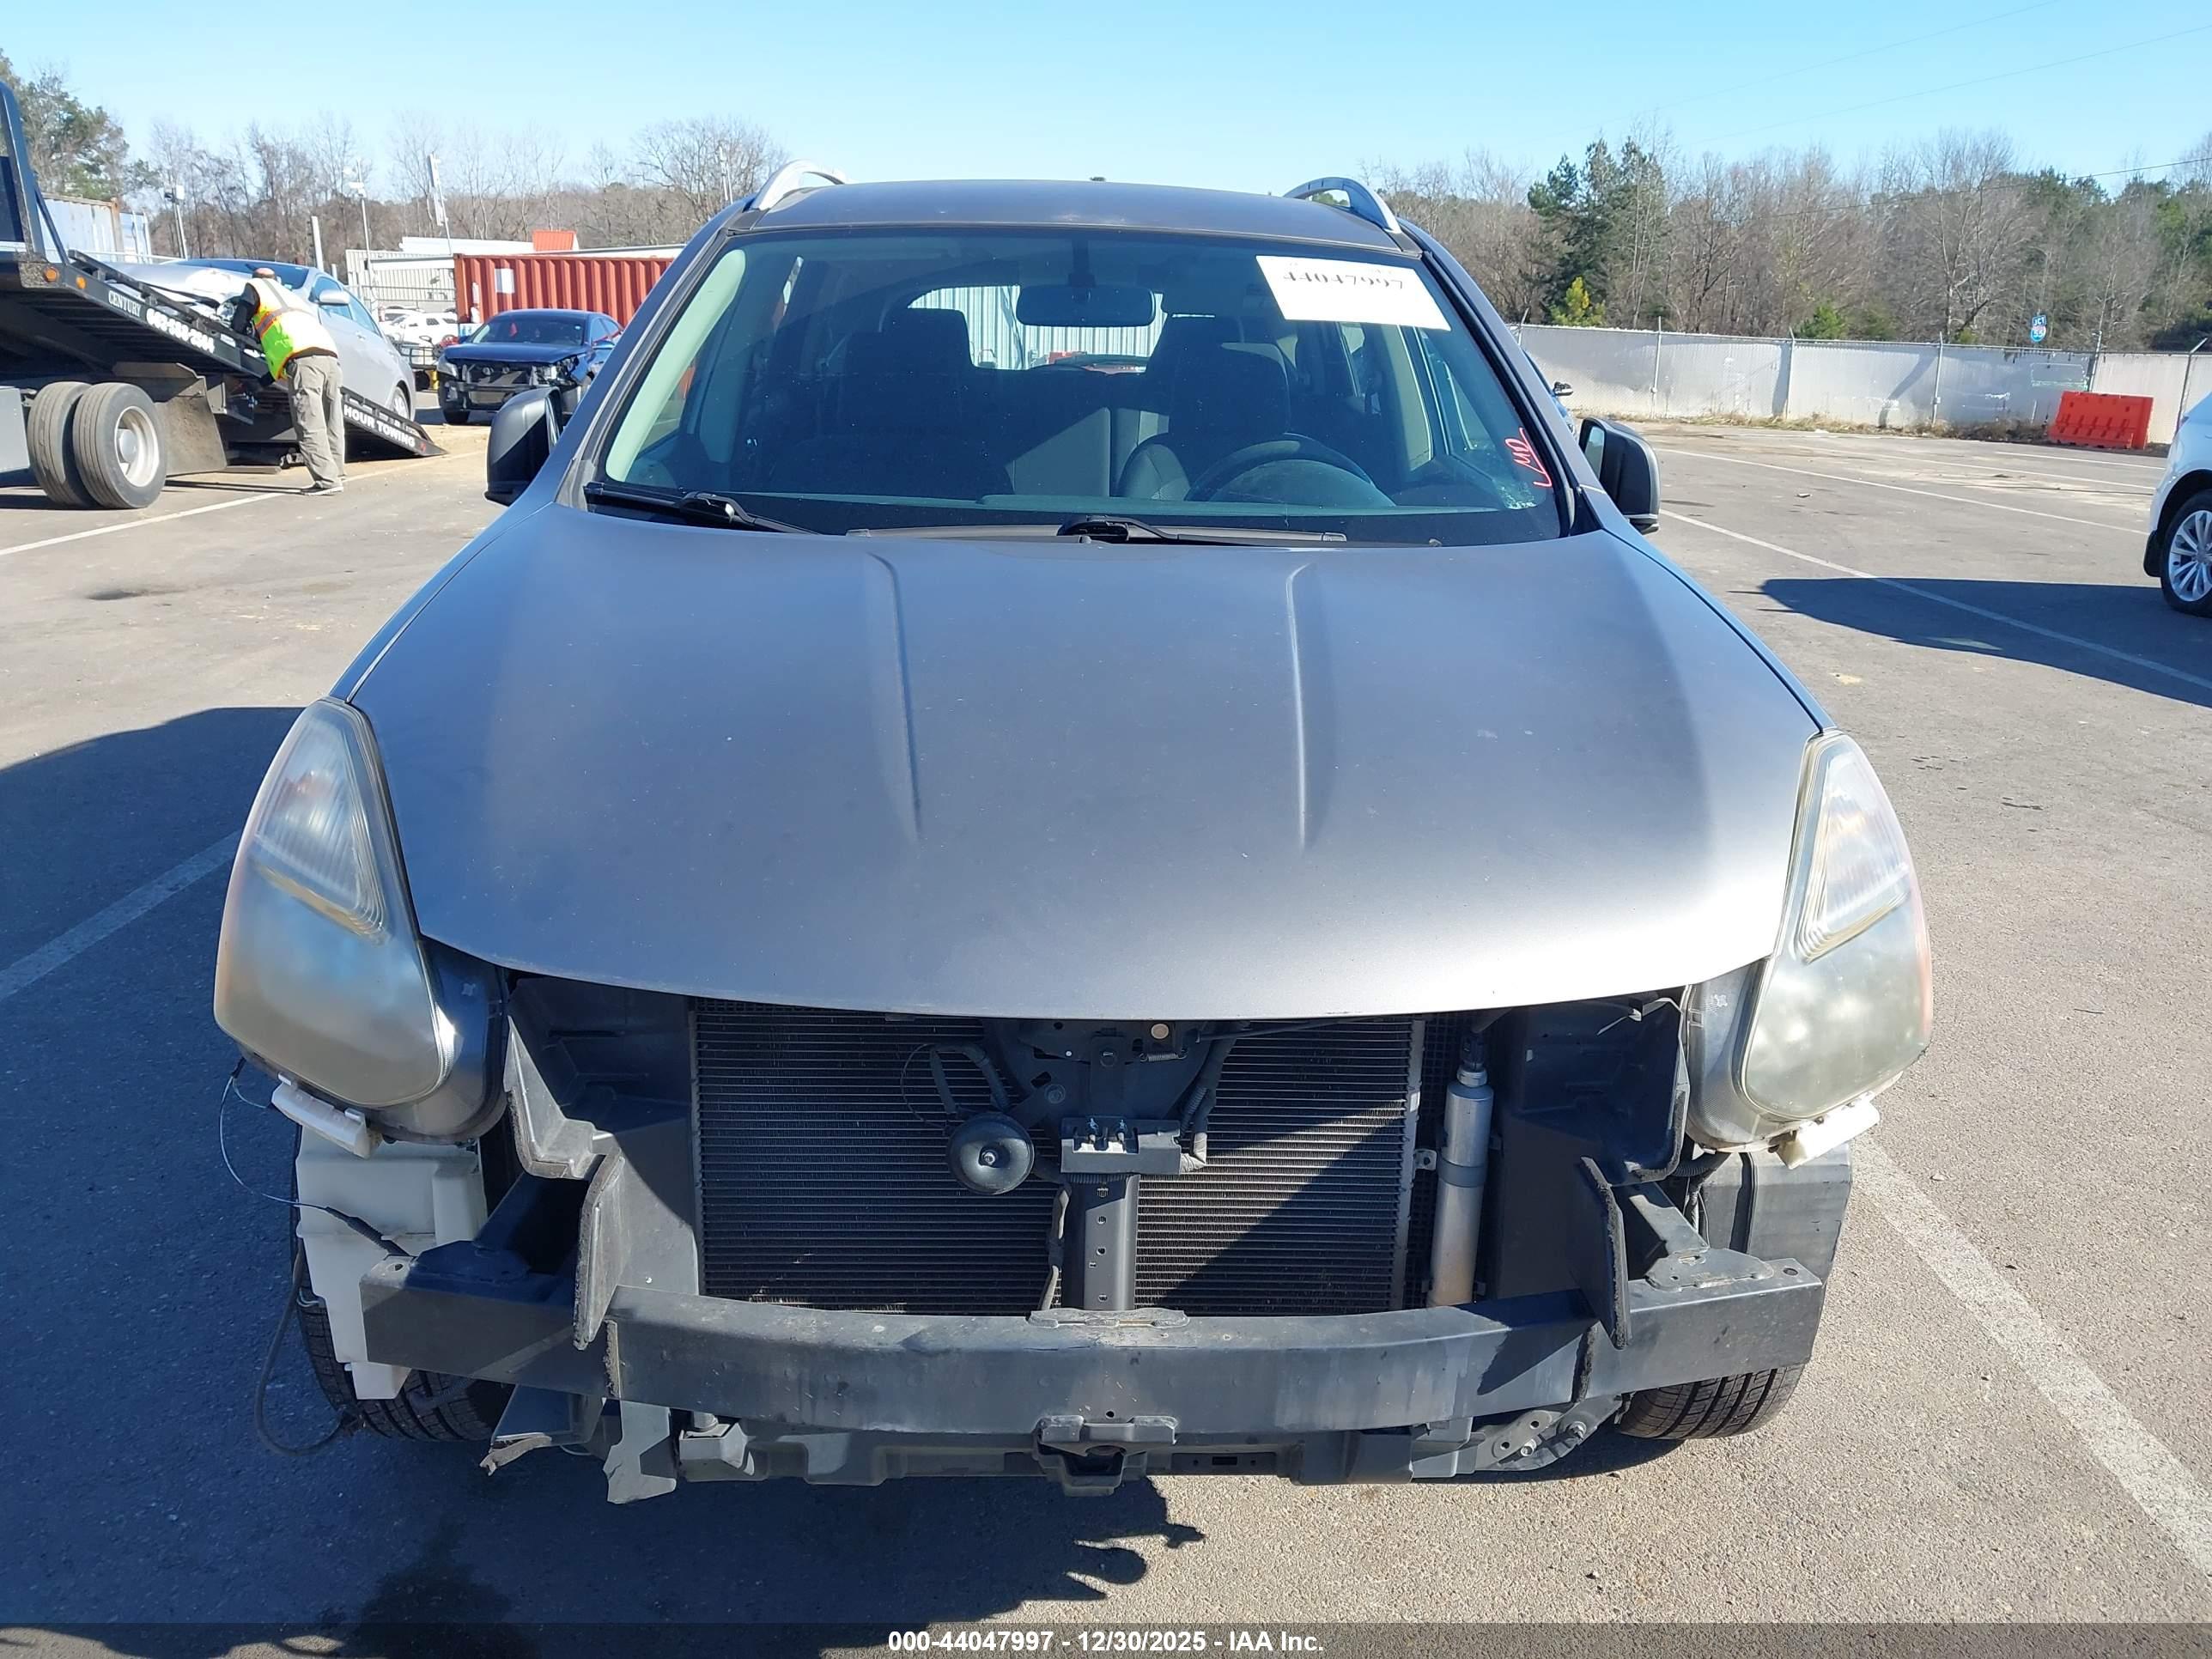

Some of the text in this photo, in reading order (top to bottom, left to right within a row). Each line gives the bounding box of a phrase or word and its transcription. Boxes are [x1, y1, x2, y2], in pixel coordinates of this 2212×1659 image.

[108, 289, 143, 318] CENTURY
[343, 404, 416, 447] HOUR TOWING
